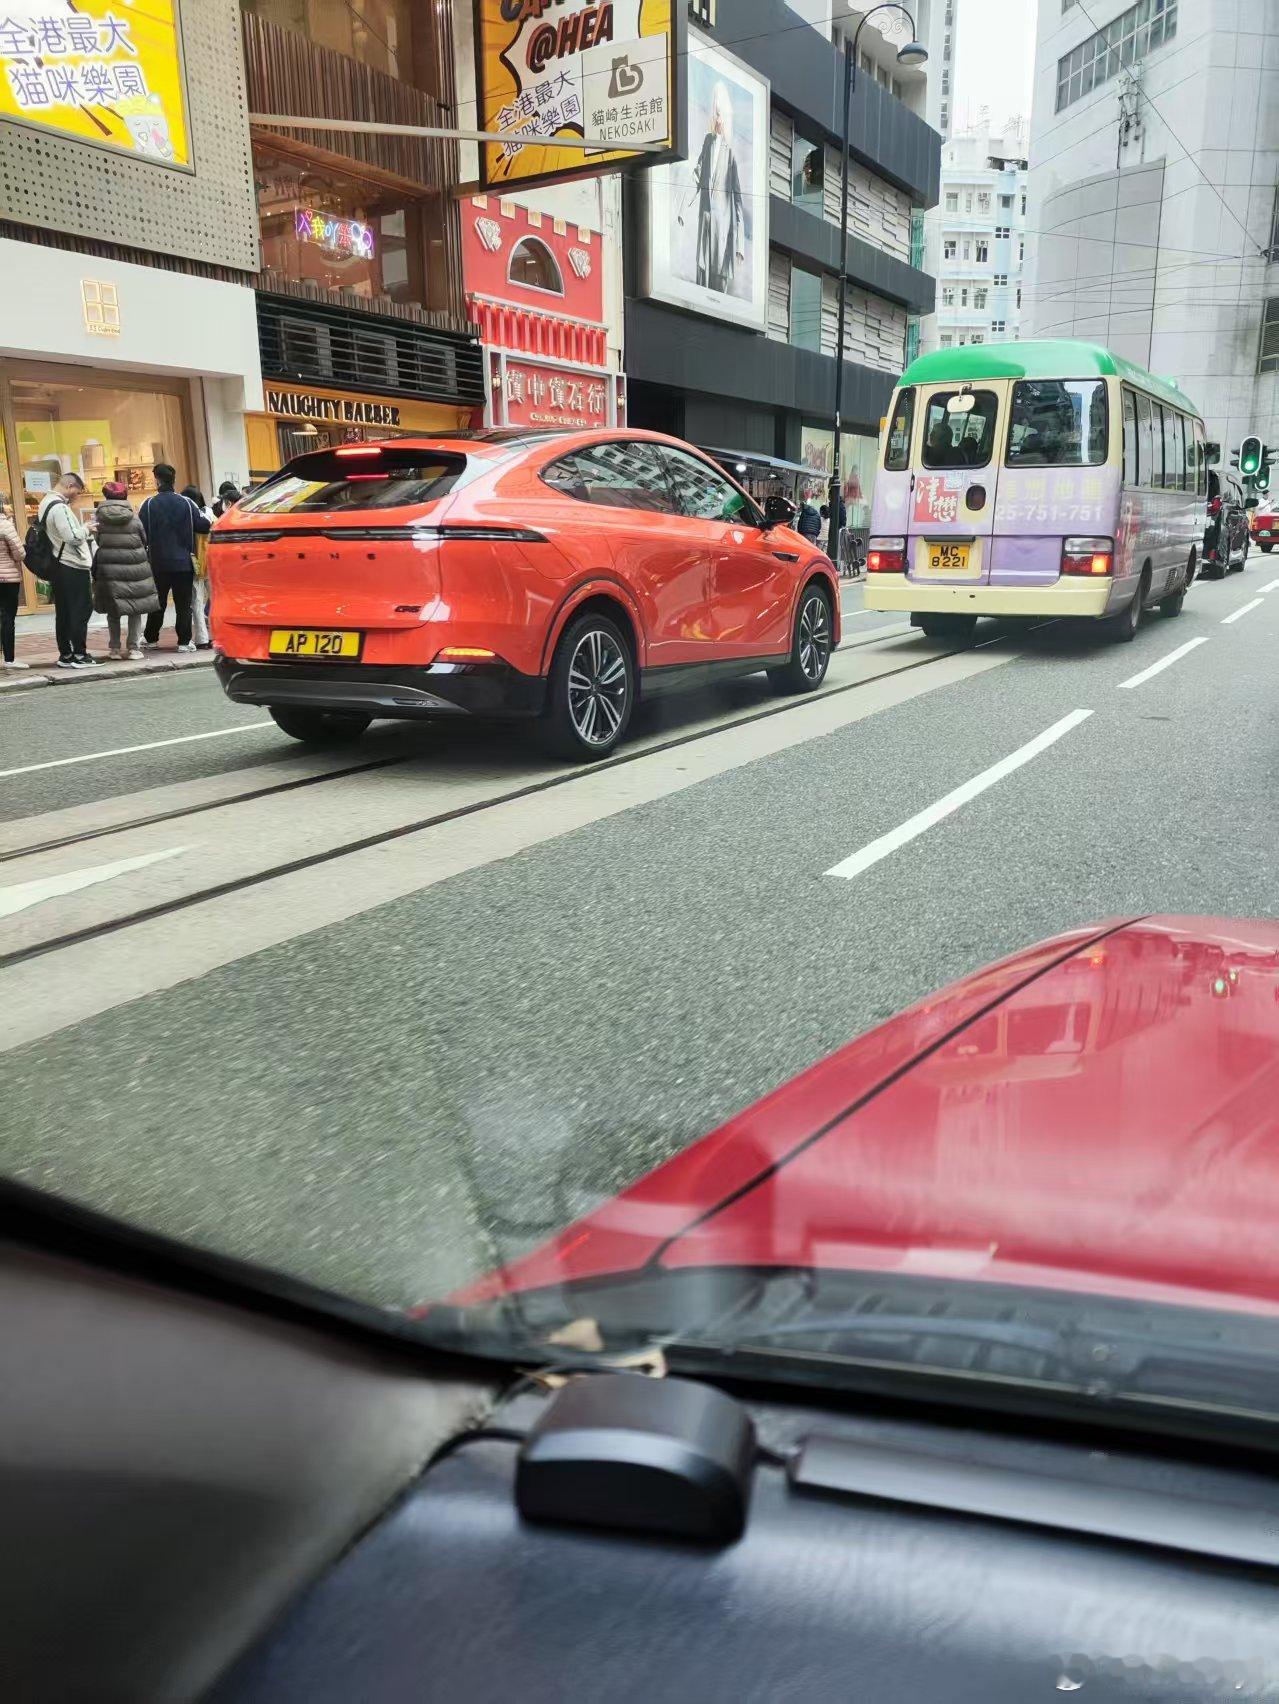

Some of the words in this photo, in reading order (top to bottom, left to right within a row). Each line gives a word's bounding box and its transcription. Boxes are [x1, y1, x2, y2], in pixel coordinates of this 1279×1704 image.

[0, 16, 135, 54] 全港最大
[526, 3, 613, 73] @HEA
[9, 65, 147, 105] 猫咪樂園
[497, 70, 575, 132] 全港最大
[592, 96, 663, 127] 貓崎生活館
[600, 118, 655, 141] NEKOSAKI
[266, 390, 342, 421] NAUGHTY
[342, 400, 400, 427] BARBER
[931, 556, 965, 567] 8221
[940, 546, 959, 557] MC
[285, 632, 308, 652] AP
[315, 634, 343, 654] 120
